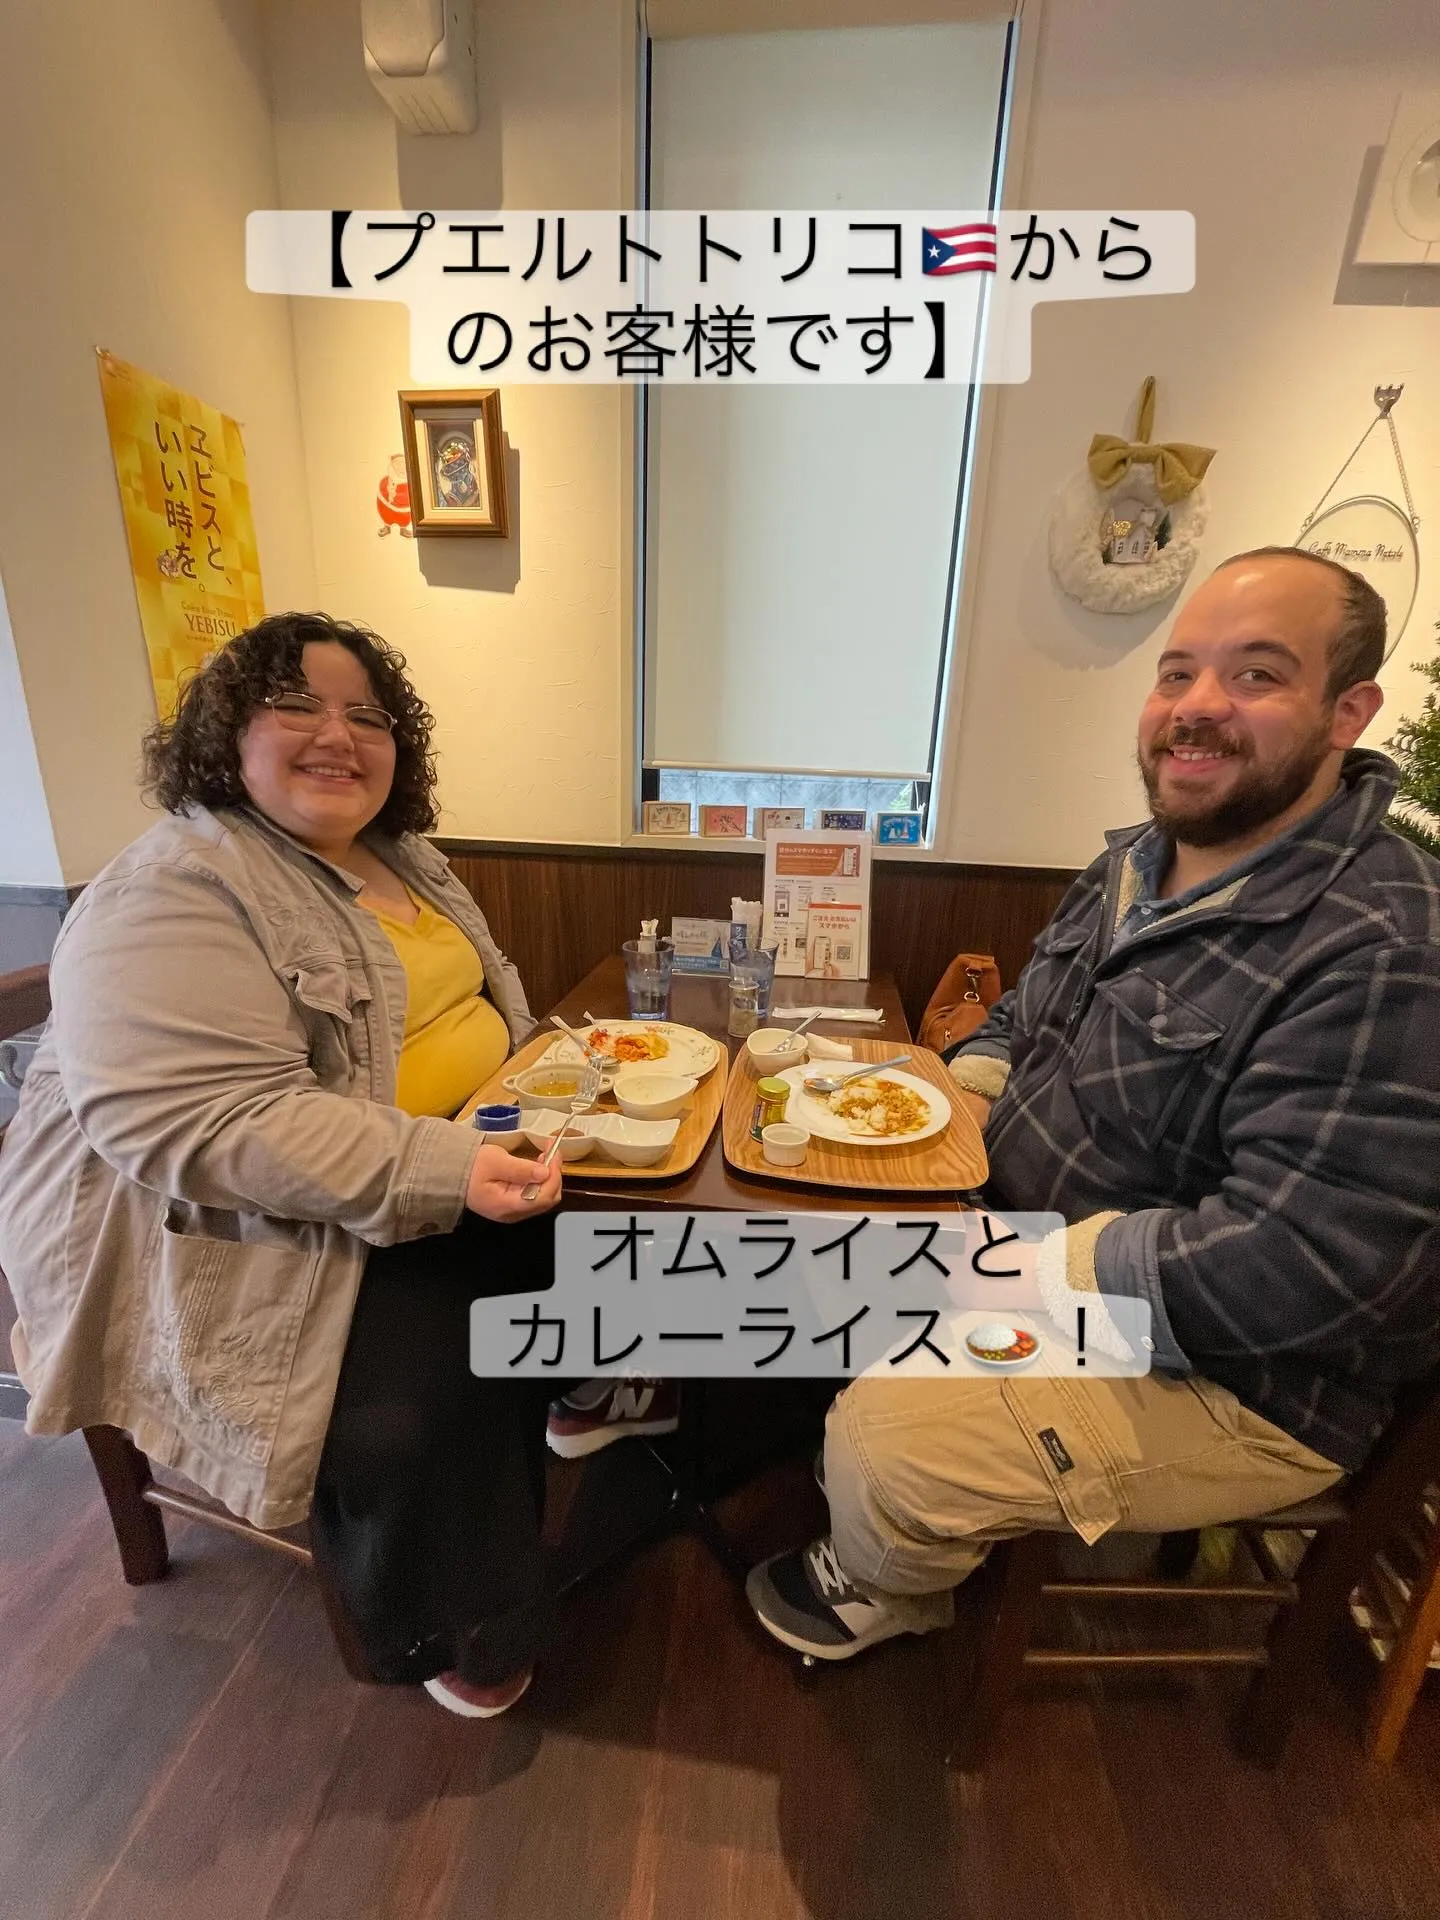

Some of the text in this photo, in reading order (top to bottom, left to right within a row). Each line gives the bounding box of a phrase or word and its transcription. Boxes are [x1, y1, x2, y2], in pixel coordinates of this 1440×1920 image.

[154, 421, 206, 593] いい時を。
[184, 613, 236, 638] YEBISU
